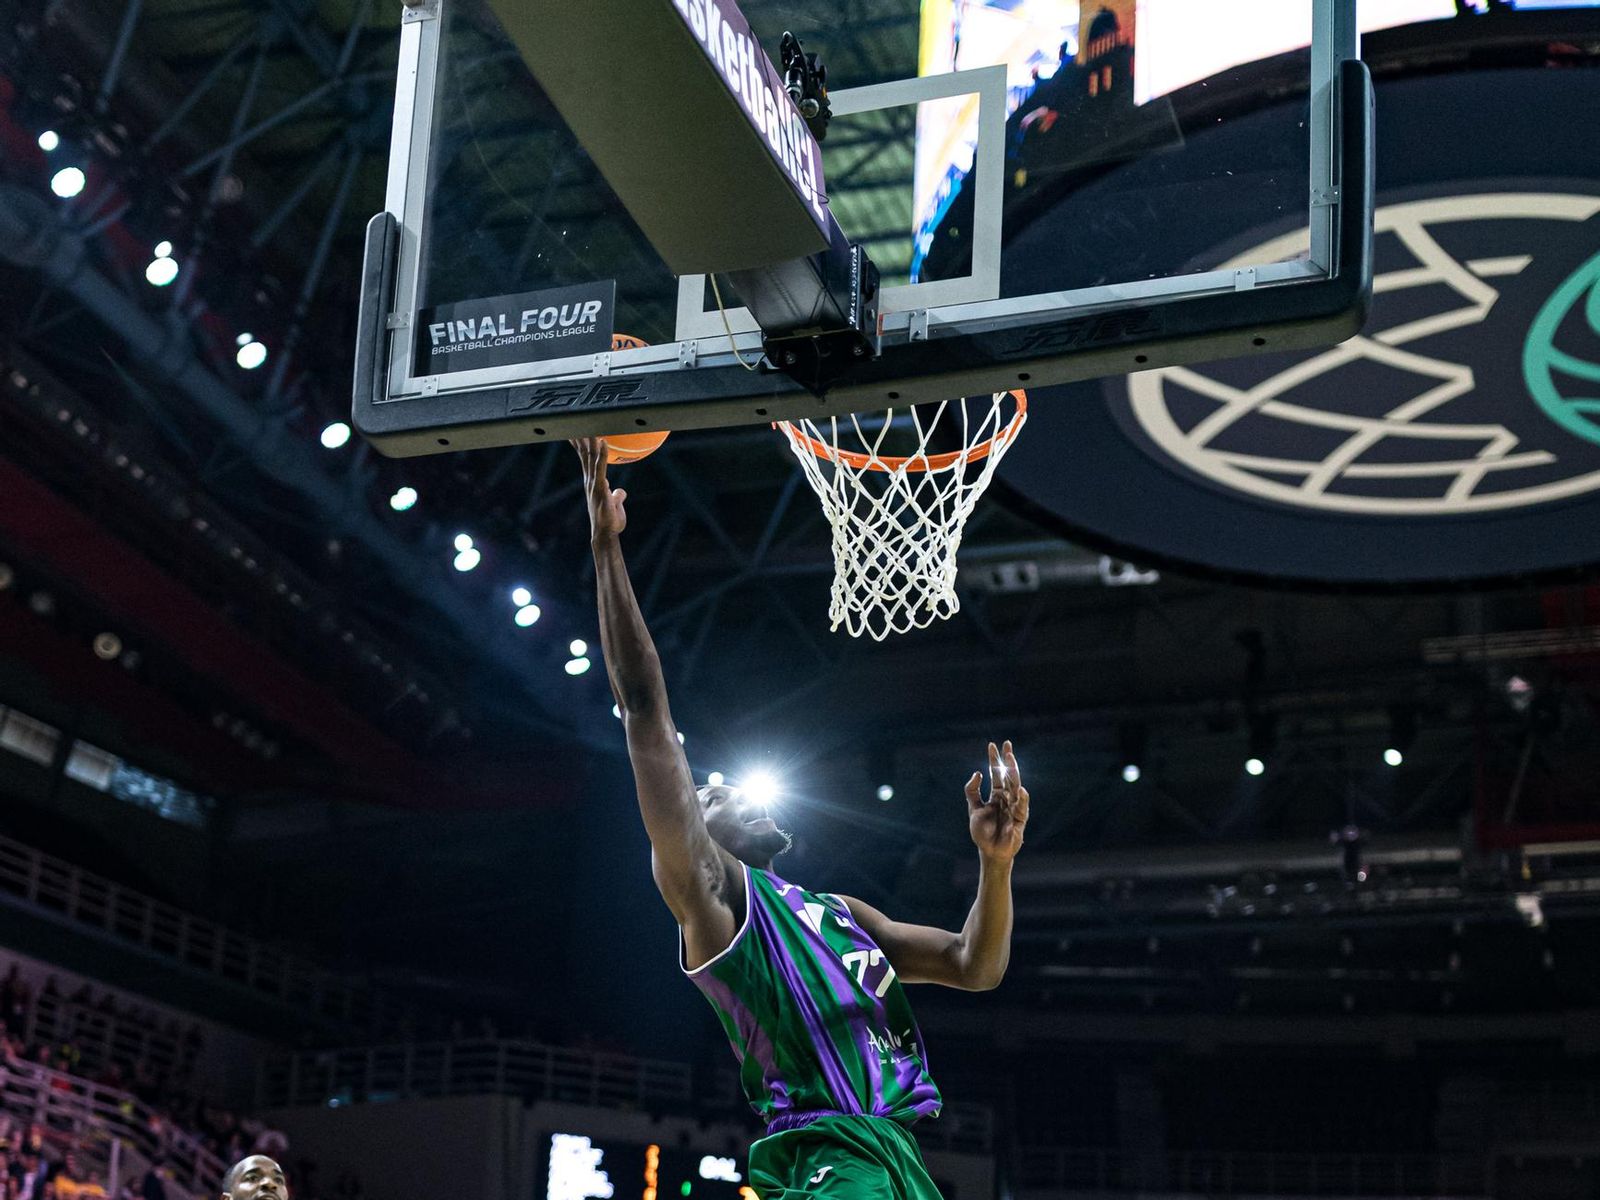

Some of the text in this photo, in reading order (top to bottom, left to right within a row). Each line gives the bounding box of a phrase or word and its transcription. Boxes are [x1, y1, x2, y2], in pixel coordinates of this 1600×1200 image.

[672, 0, 824, 222] sketballCL
[428, 300, 602, 345] FINAL FOUR
[431, 324, 596, 356] BASKETBALL CHAMPIONS LEAGUE
[841, 948, 897, 998] 77
